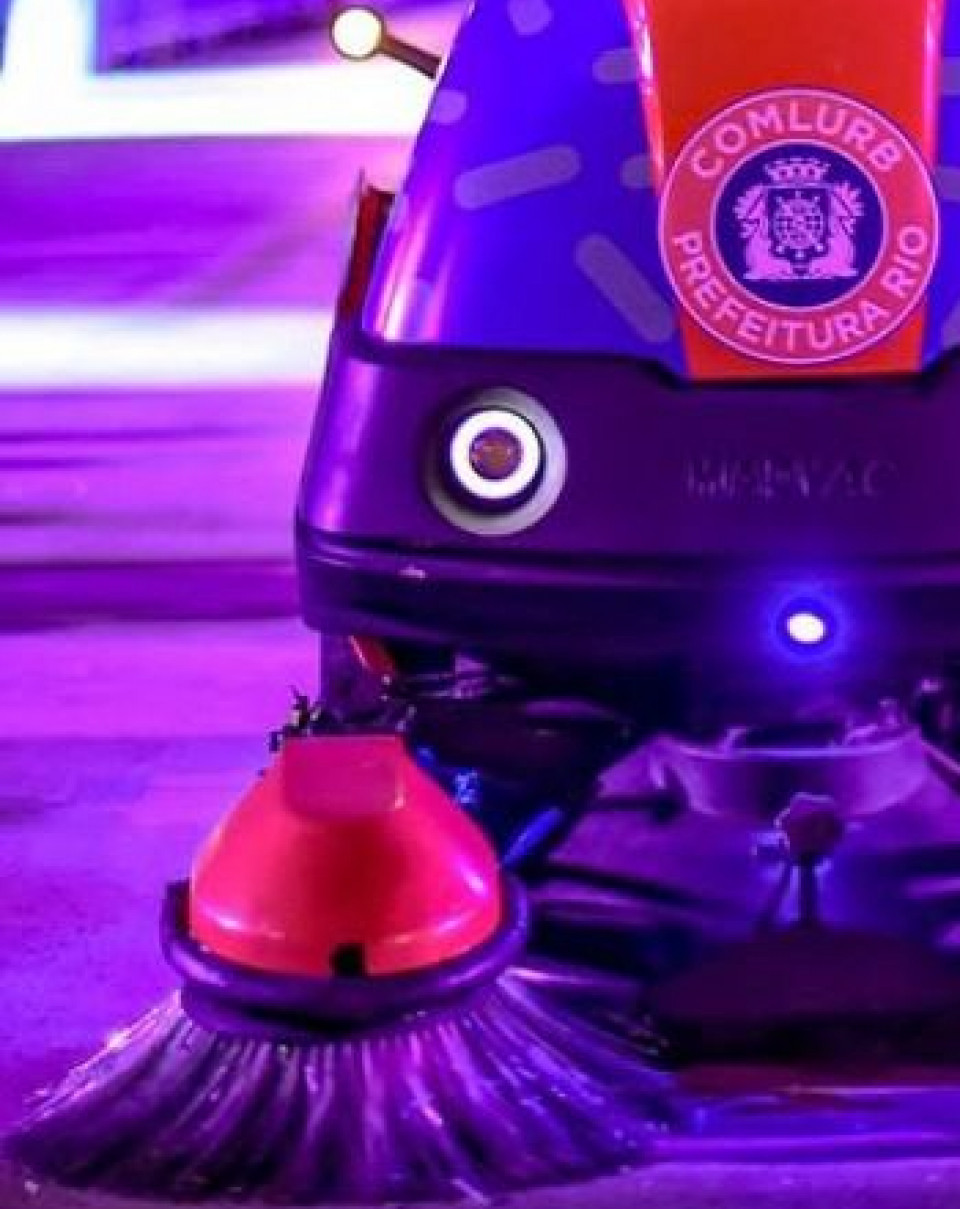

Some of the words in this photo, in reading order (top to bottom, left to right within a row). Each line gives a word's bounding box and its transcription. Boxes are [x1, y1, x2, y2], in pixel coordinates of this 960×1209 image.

[690, 101, 902, 178] COMLURB
[671, 231, 890, 351] PREFEITURA
[879, 225, 928, 297] RIO
